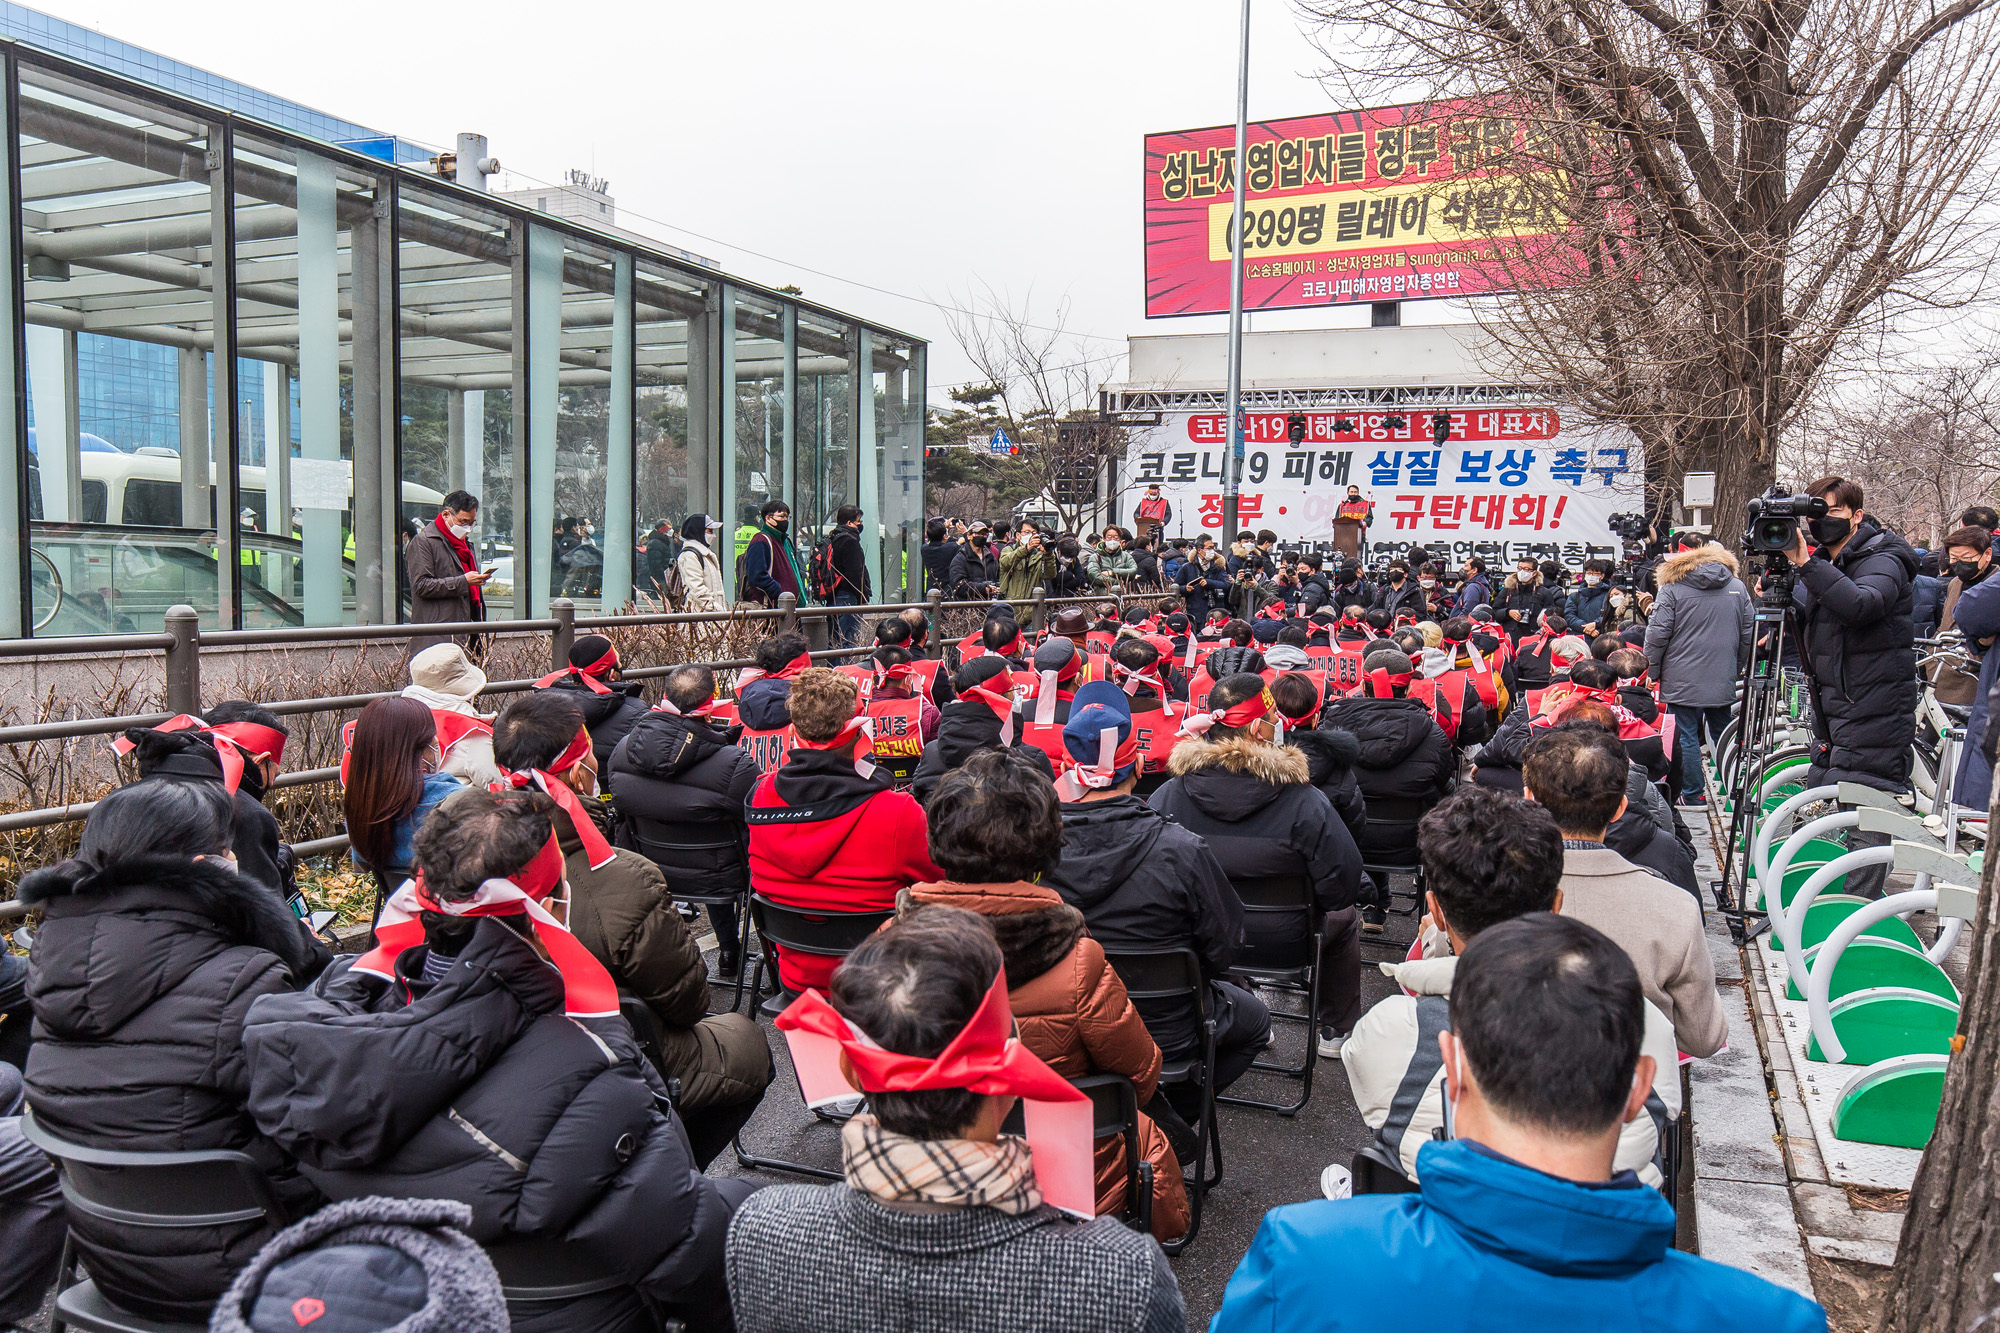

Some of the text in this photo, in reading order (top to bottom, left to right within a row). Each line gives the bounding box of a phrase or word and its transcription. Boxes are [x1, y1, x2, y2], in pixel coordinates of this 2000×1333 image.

[1375, 126, 1439, 178] 정부
[1336, 194, 1430, 243] 릴레이
[1245, 259, 1315, 280] (소송홈페이지
[1326, 252, 1406, 272] 성난자영업자들
[1301, 271, 1460, 298] 코로나피해자영업자총연합
[1478, 411, 1550, 438] 대표자
[1282, 451, 1353, 486] 피해
[1367, 449, 1442, 486] 실질
[1455, 449, 1537, 487] 보상
[1550, 448, 1630, 486] 촉구
[1390, 493, 1569, 531] 규탄대회!
[750, 810, 814, 820] TRAINING
